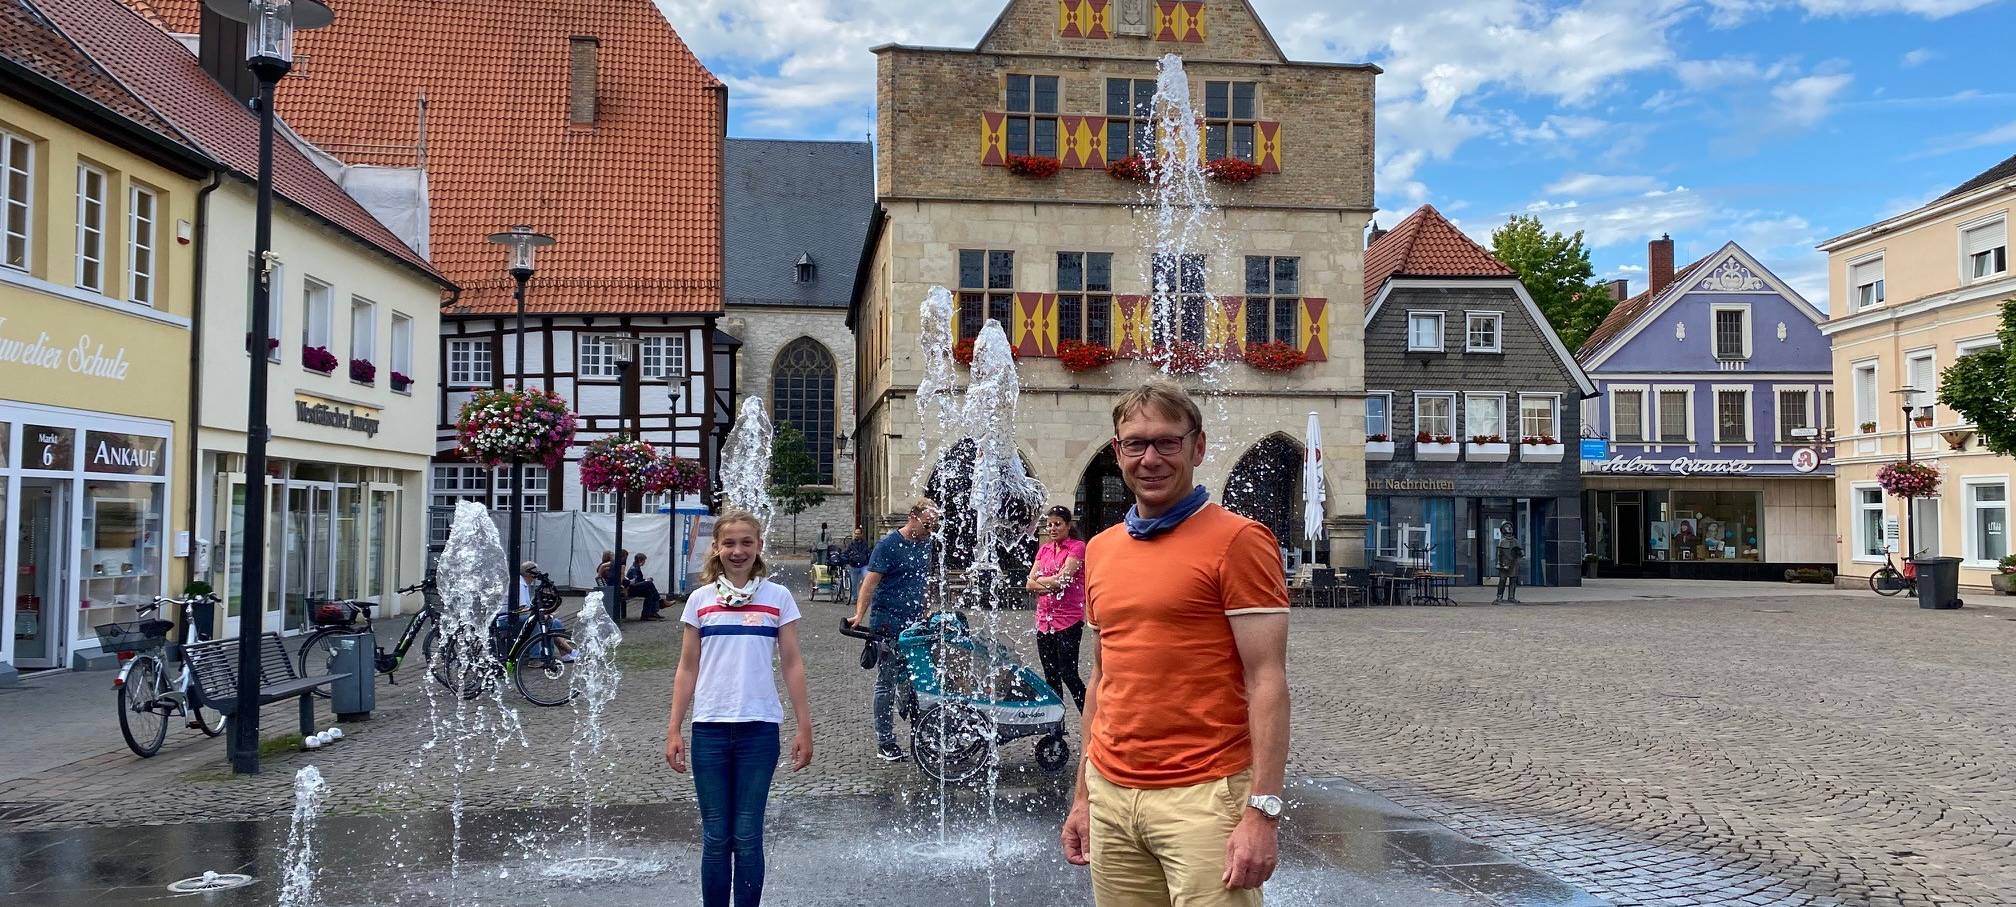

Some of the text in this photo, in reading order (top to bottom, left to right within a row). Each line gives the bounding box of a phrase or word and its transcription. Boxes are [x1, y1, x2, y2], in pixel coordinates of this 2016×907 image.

[68, 334, 129, 380] Schulz
[347, 409, 380, 438] Anzeiger
[38, 433, 58, 444] Markt
[42, 445, 53, 466] 6
[93, 440, 157, 467] ANKAUF
[1601, 454, 1754, 476] Salon Quante
[1385, 478, 1455, 491] Nachrichten
